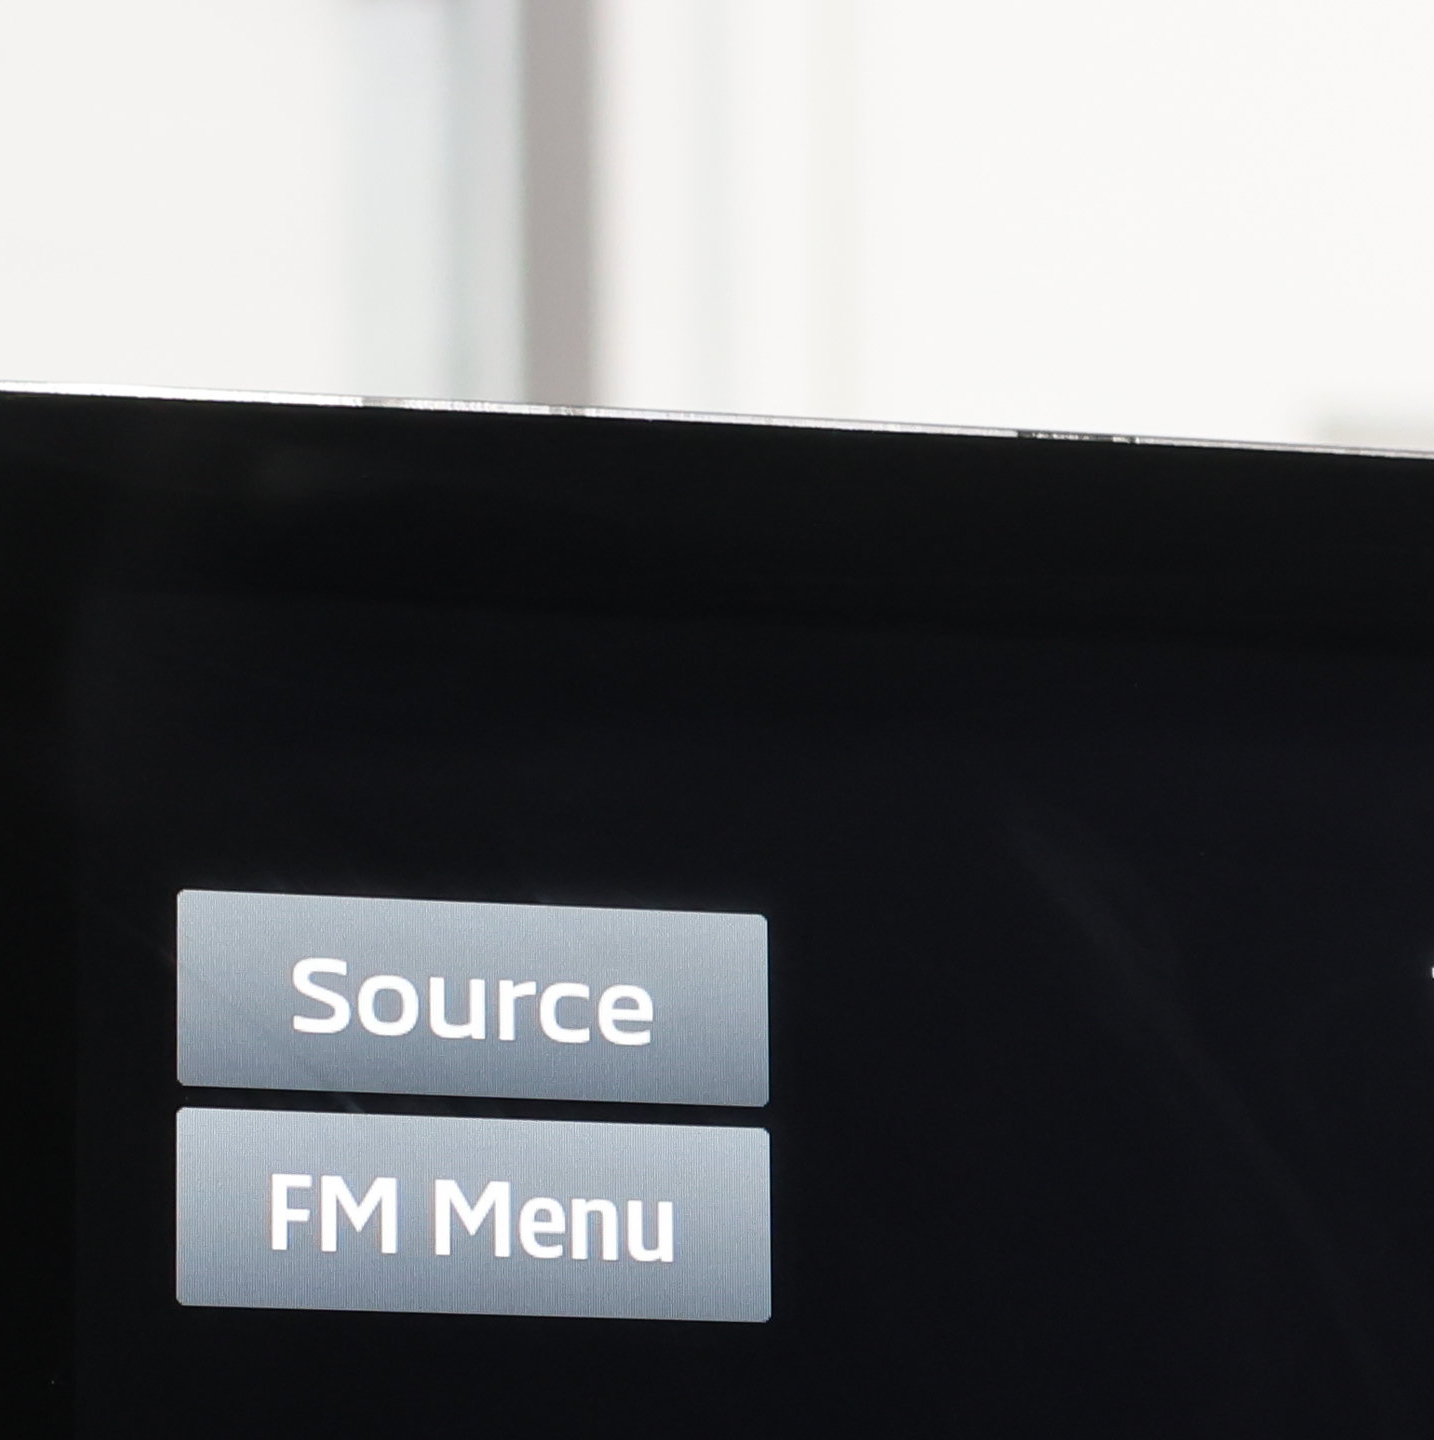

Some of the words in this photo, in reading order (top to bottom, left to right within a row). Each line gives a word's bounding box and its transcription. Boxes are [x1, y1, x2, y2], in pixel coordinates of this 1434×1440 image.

[291, 957, 654, 1046] Source
[269, 1173, 398, 1254] FM
[434, 1178, 674, 1263] Menu
